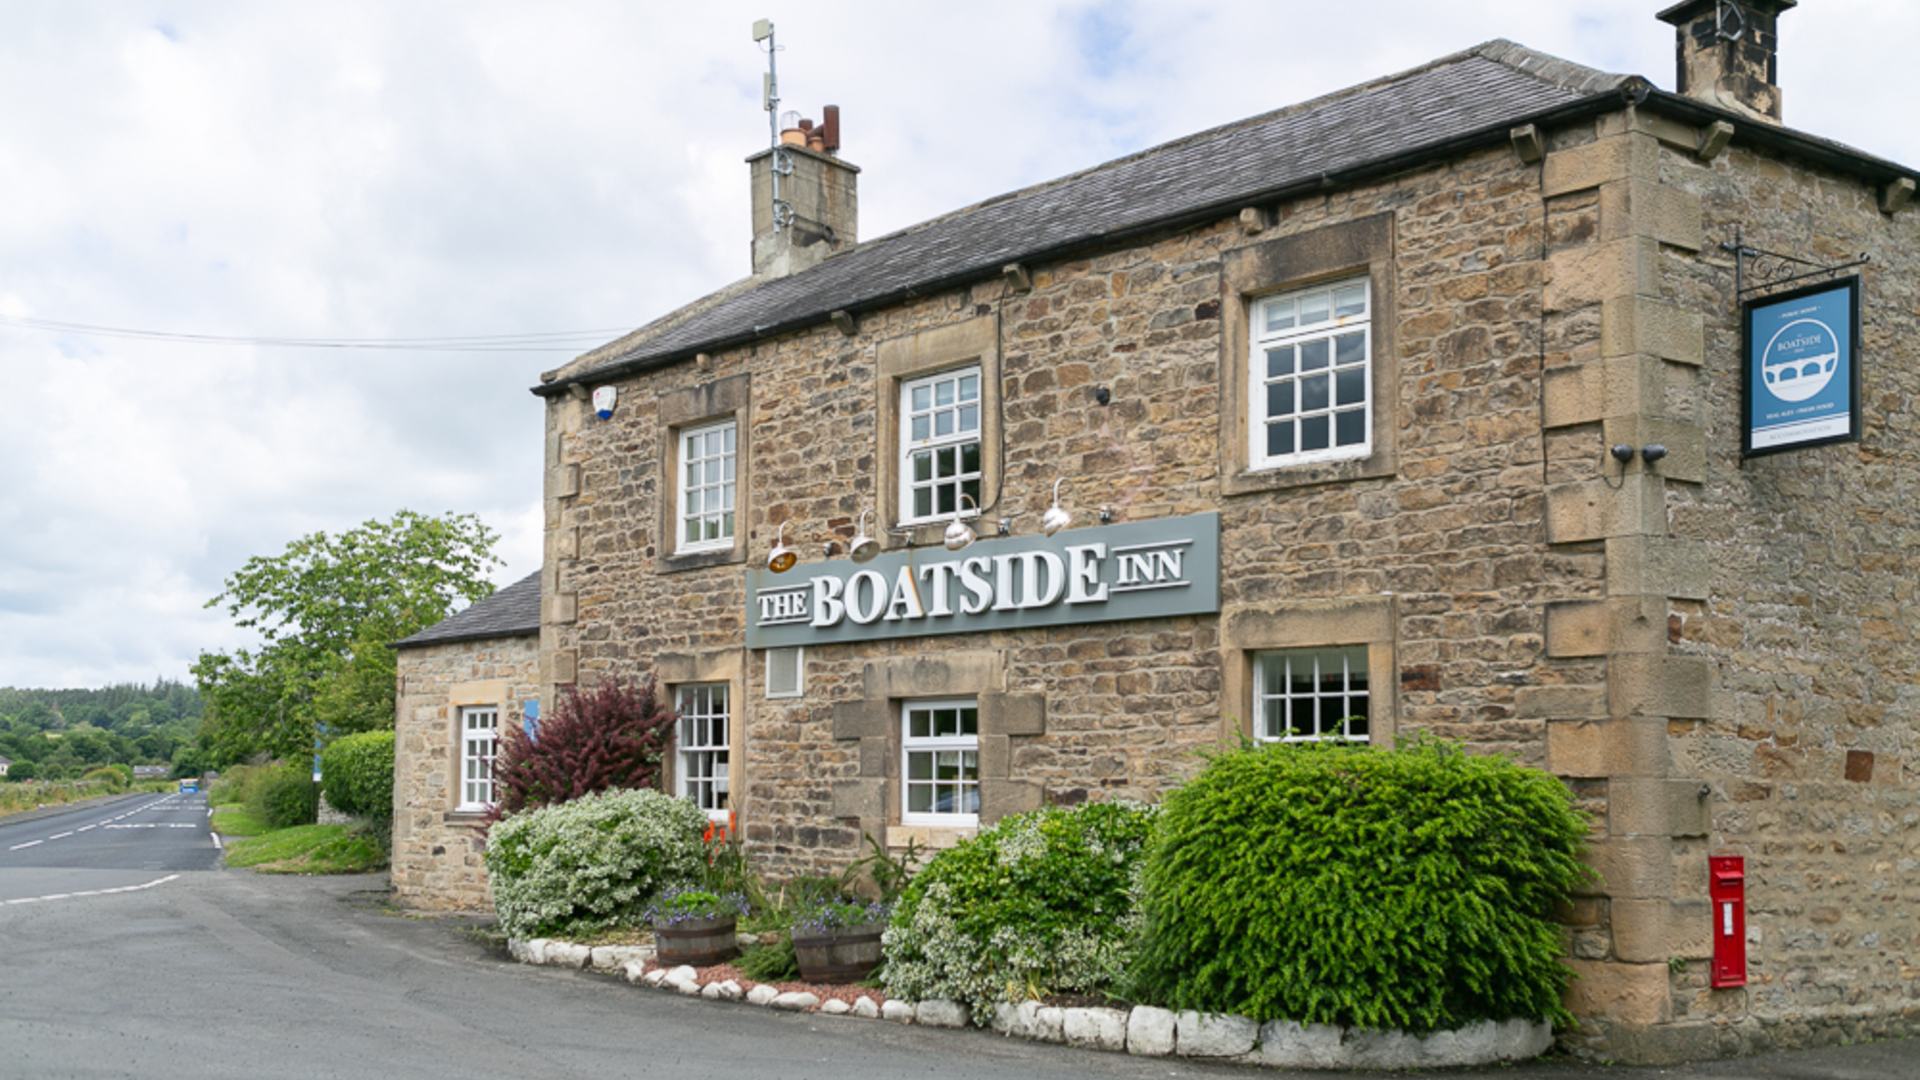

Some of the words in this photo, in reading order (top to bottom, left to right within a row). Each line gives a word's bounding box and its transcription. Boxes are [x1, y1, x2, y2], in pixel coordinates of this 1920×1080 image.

[1777, 334, 1822, 352] BOATSIDE
[757, 590, 808, 621] THE
[810, 543, 1109, 627] BOATSIDE
[1115, 549, 1186, 585] INN
